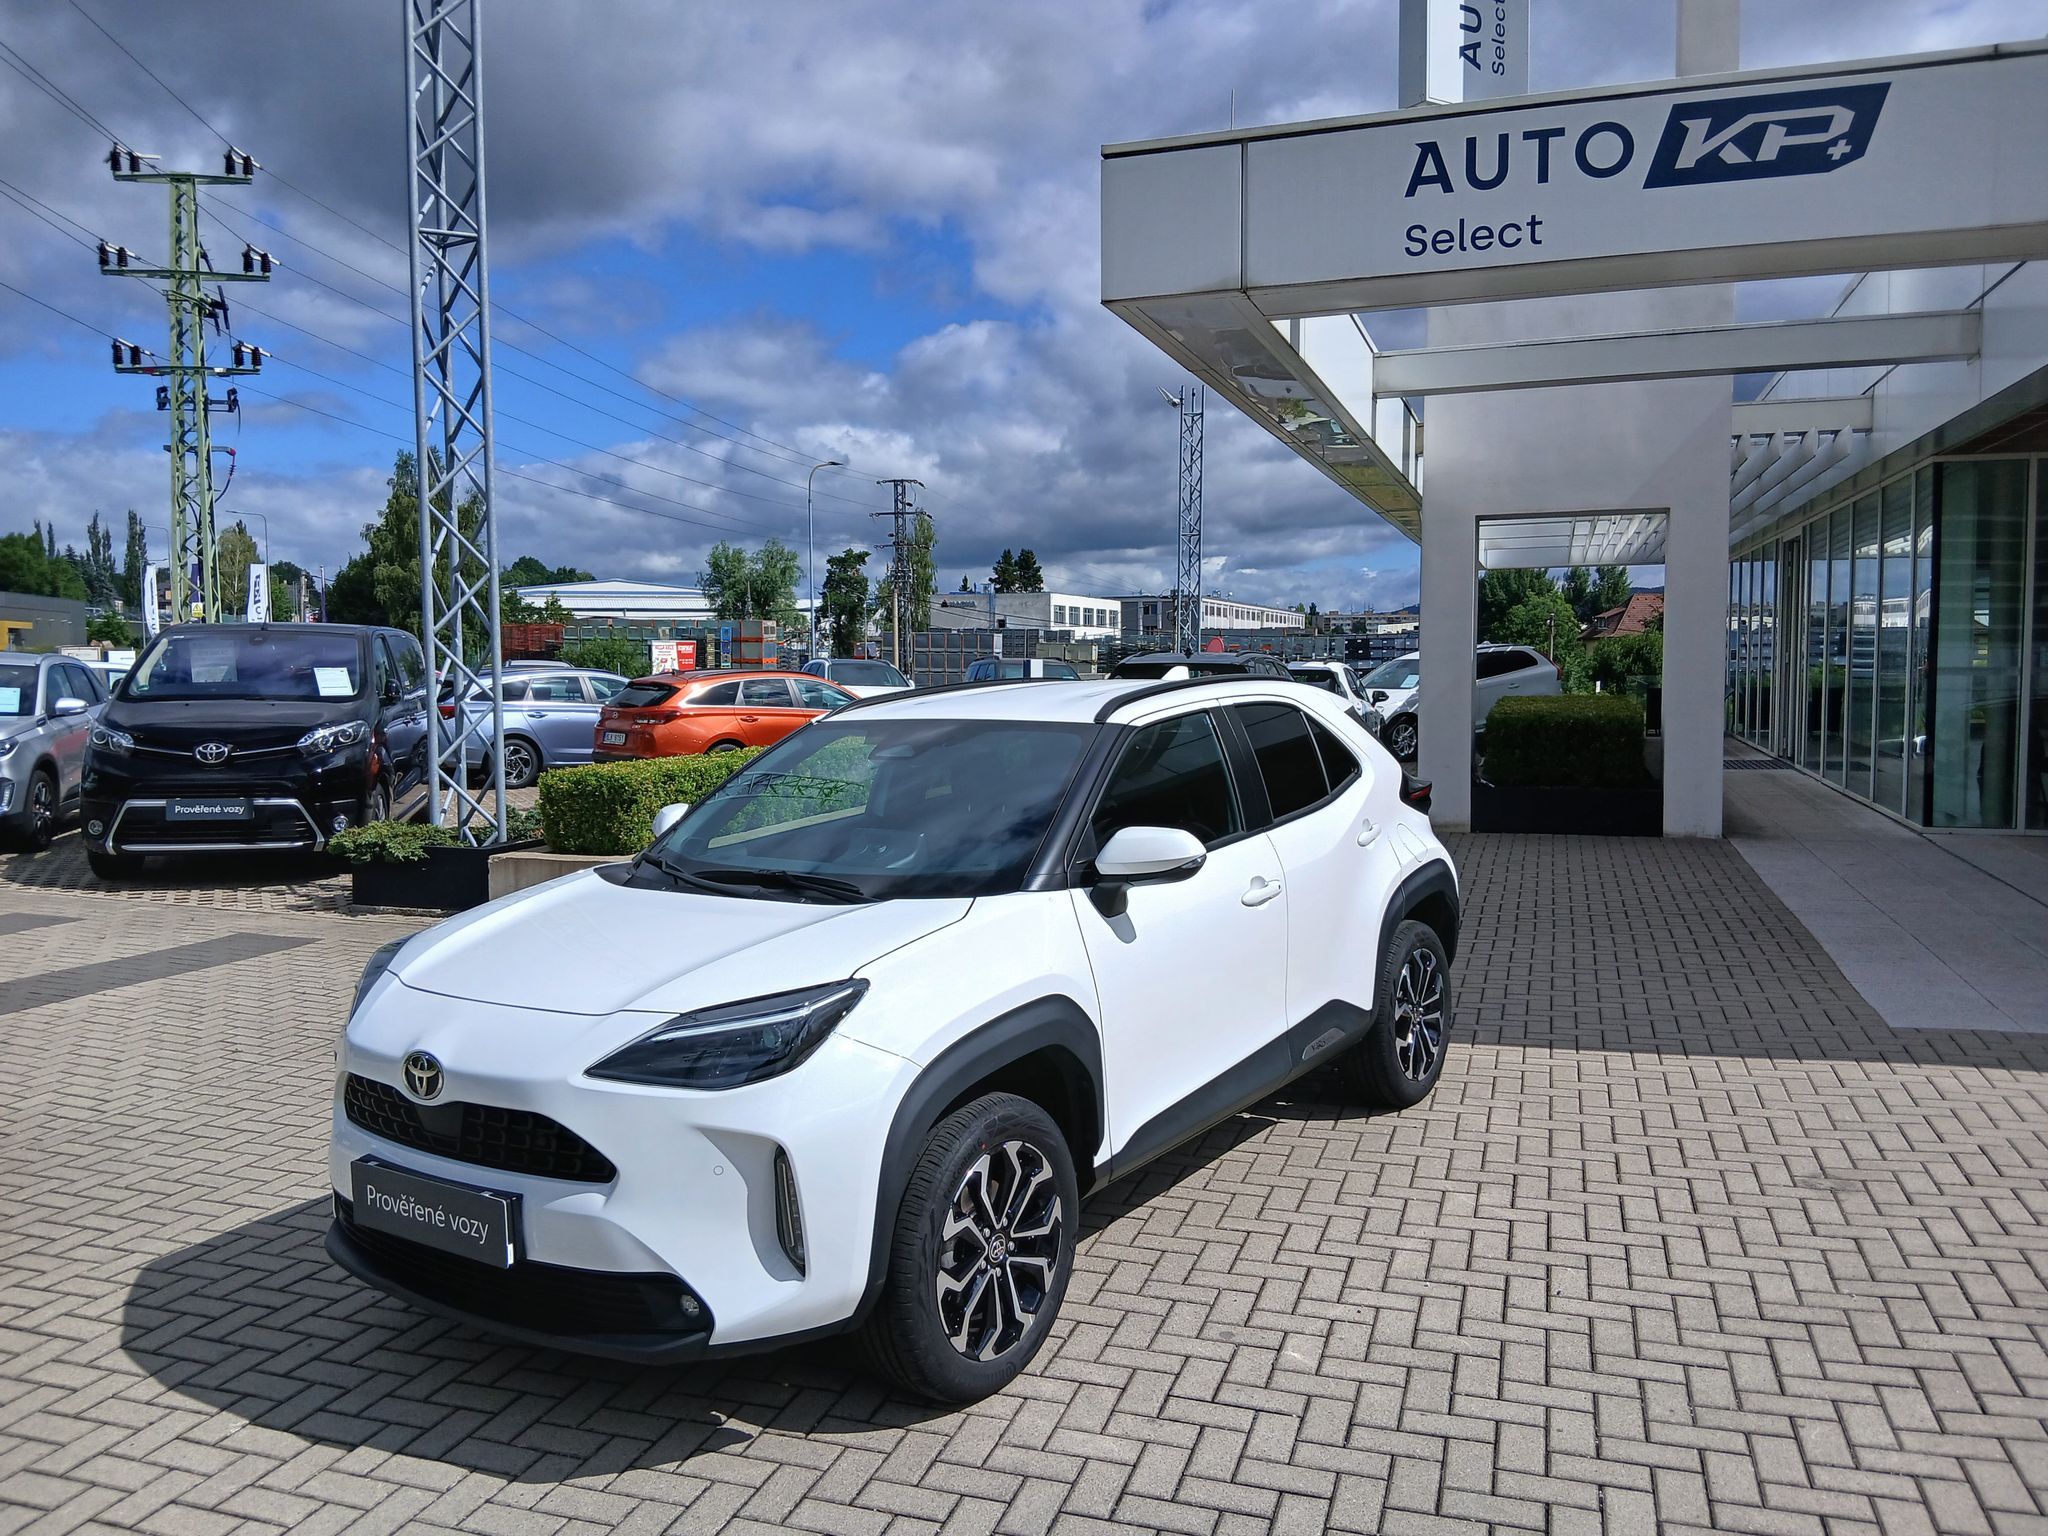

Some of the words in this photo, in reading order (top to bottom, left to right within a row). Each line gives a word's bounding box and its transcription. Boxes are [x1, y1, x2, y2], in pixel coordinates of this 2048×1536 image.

[1404, 121, 1634, 198] AUTO
[1404, 215, 1543, 257] Select
[175, 804, 222, 814] Prověřené
[223, 805, 245, 815] vozy
[367, 1184, 446, 1228] Prověřené
[449, 1213, 489, 1245] vozy
